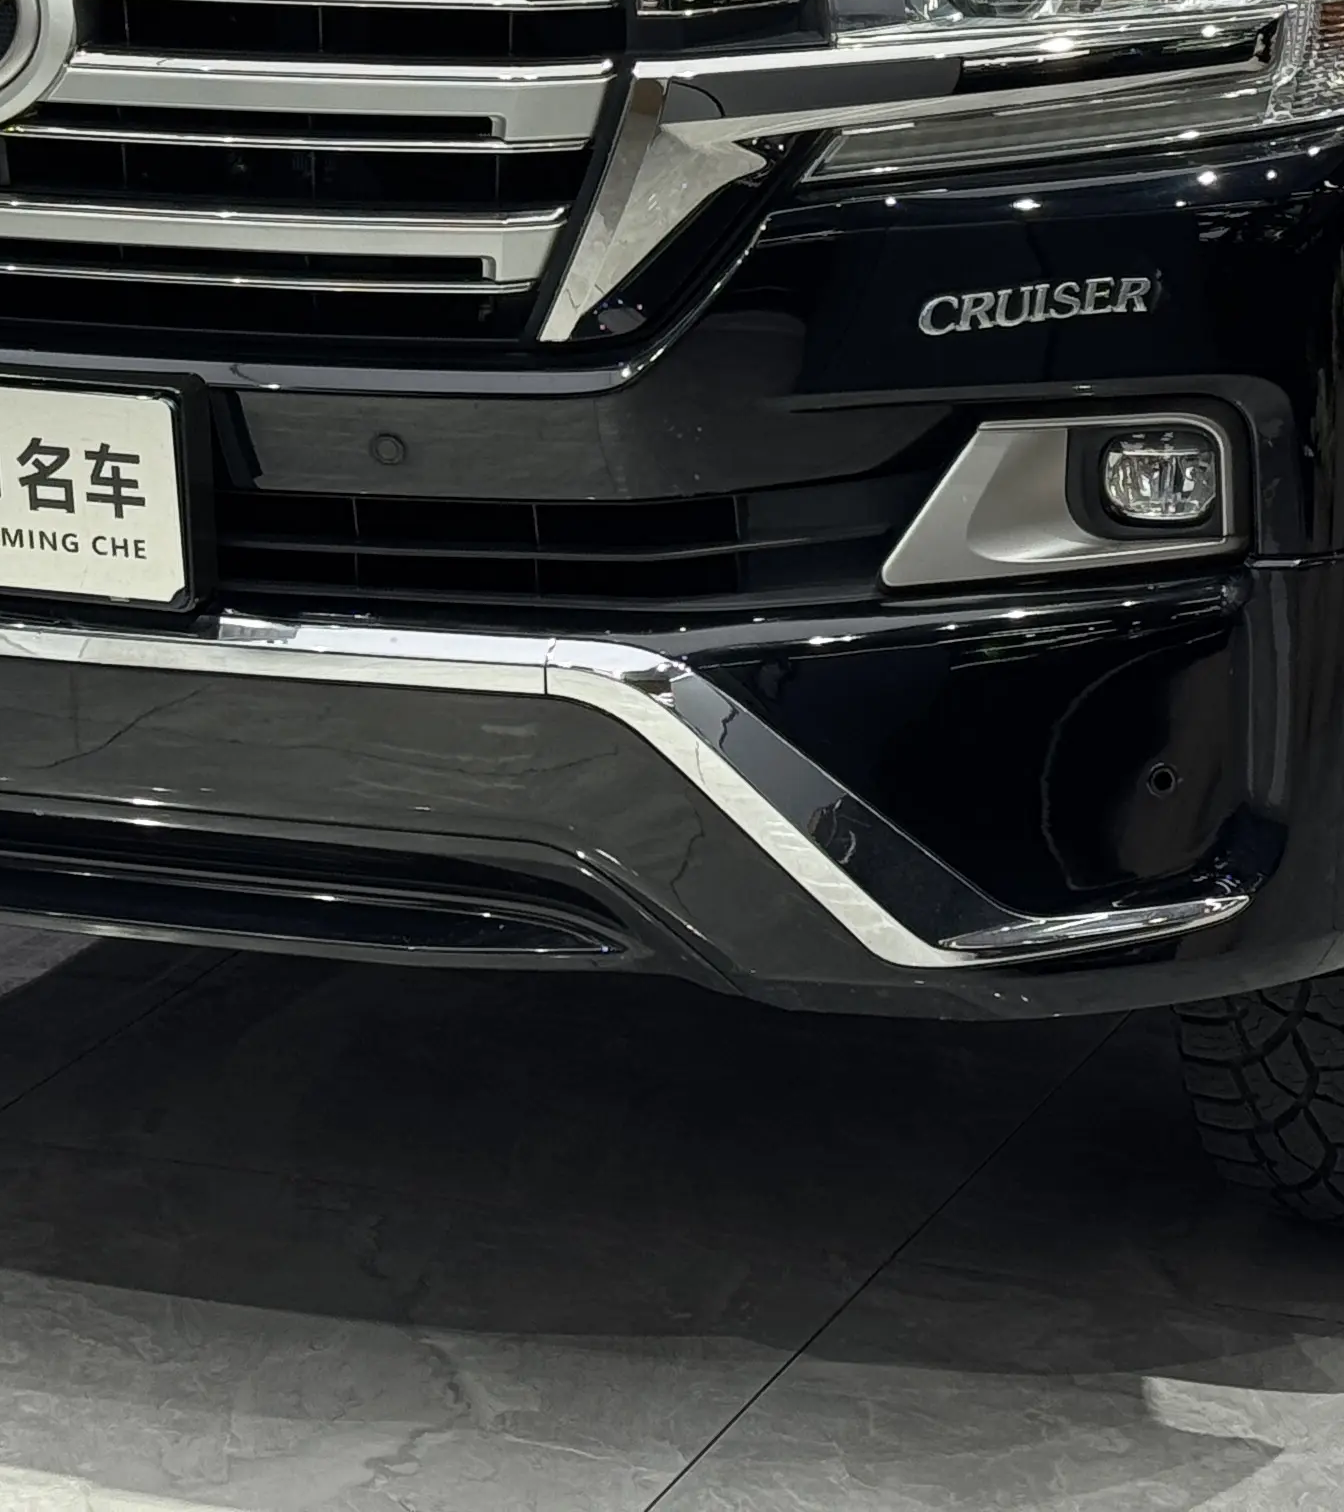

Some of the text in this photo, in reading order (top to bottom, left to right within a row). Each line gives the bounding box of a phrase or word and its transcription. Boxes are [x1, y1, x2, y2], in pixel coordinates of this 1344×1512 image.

[918, 276, 1152, 336] CRUISER
[1, 527, 79, 553] MING
[91, 535, 146, 560] CHE
